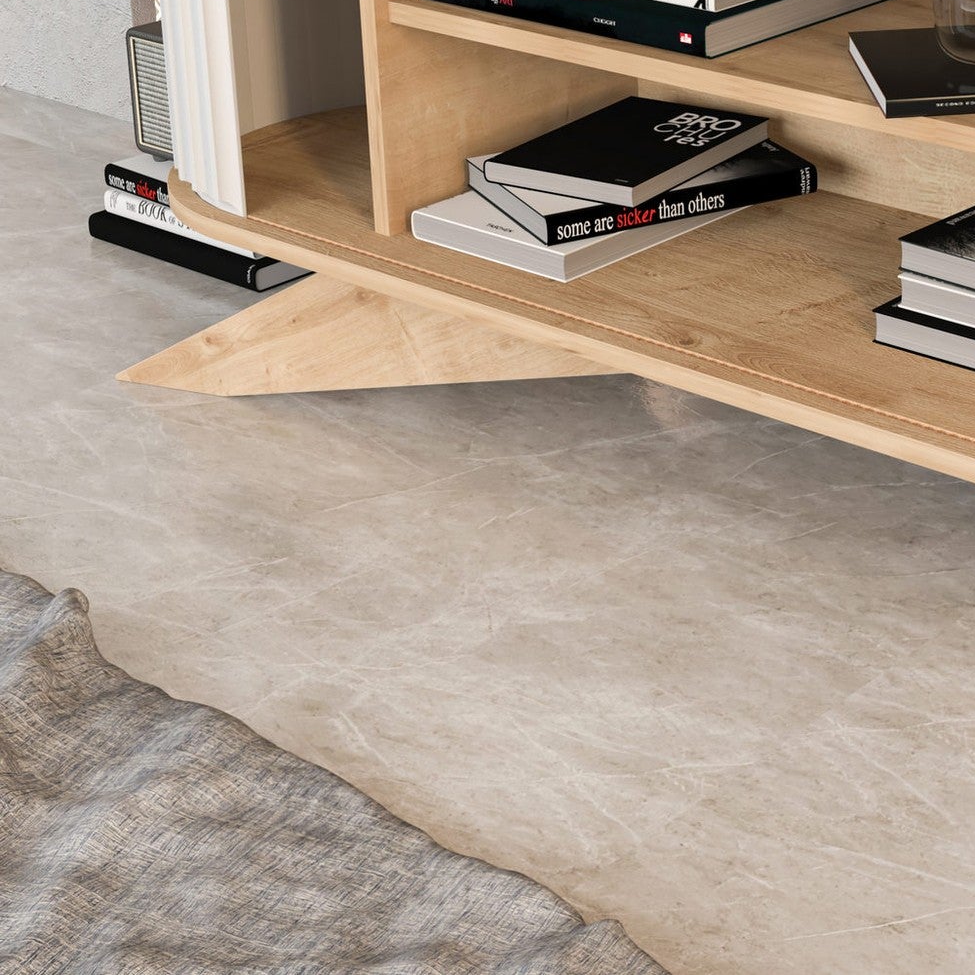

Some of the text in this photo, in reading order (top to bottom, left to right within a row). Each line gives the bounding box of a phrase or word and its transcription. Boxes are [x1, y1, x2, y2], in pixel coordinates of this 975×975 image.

[653, 122, 727, 140] CHU
[667, 112, 742, 131] BRO
[663, 134, 710, 147] res
[108, 174, 126, 190] some
[125, 180, 136, 194] are
[136, 178, 157, 201] sicker
[557, 192, 726, 240] some are sicker than others
